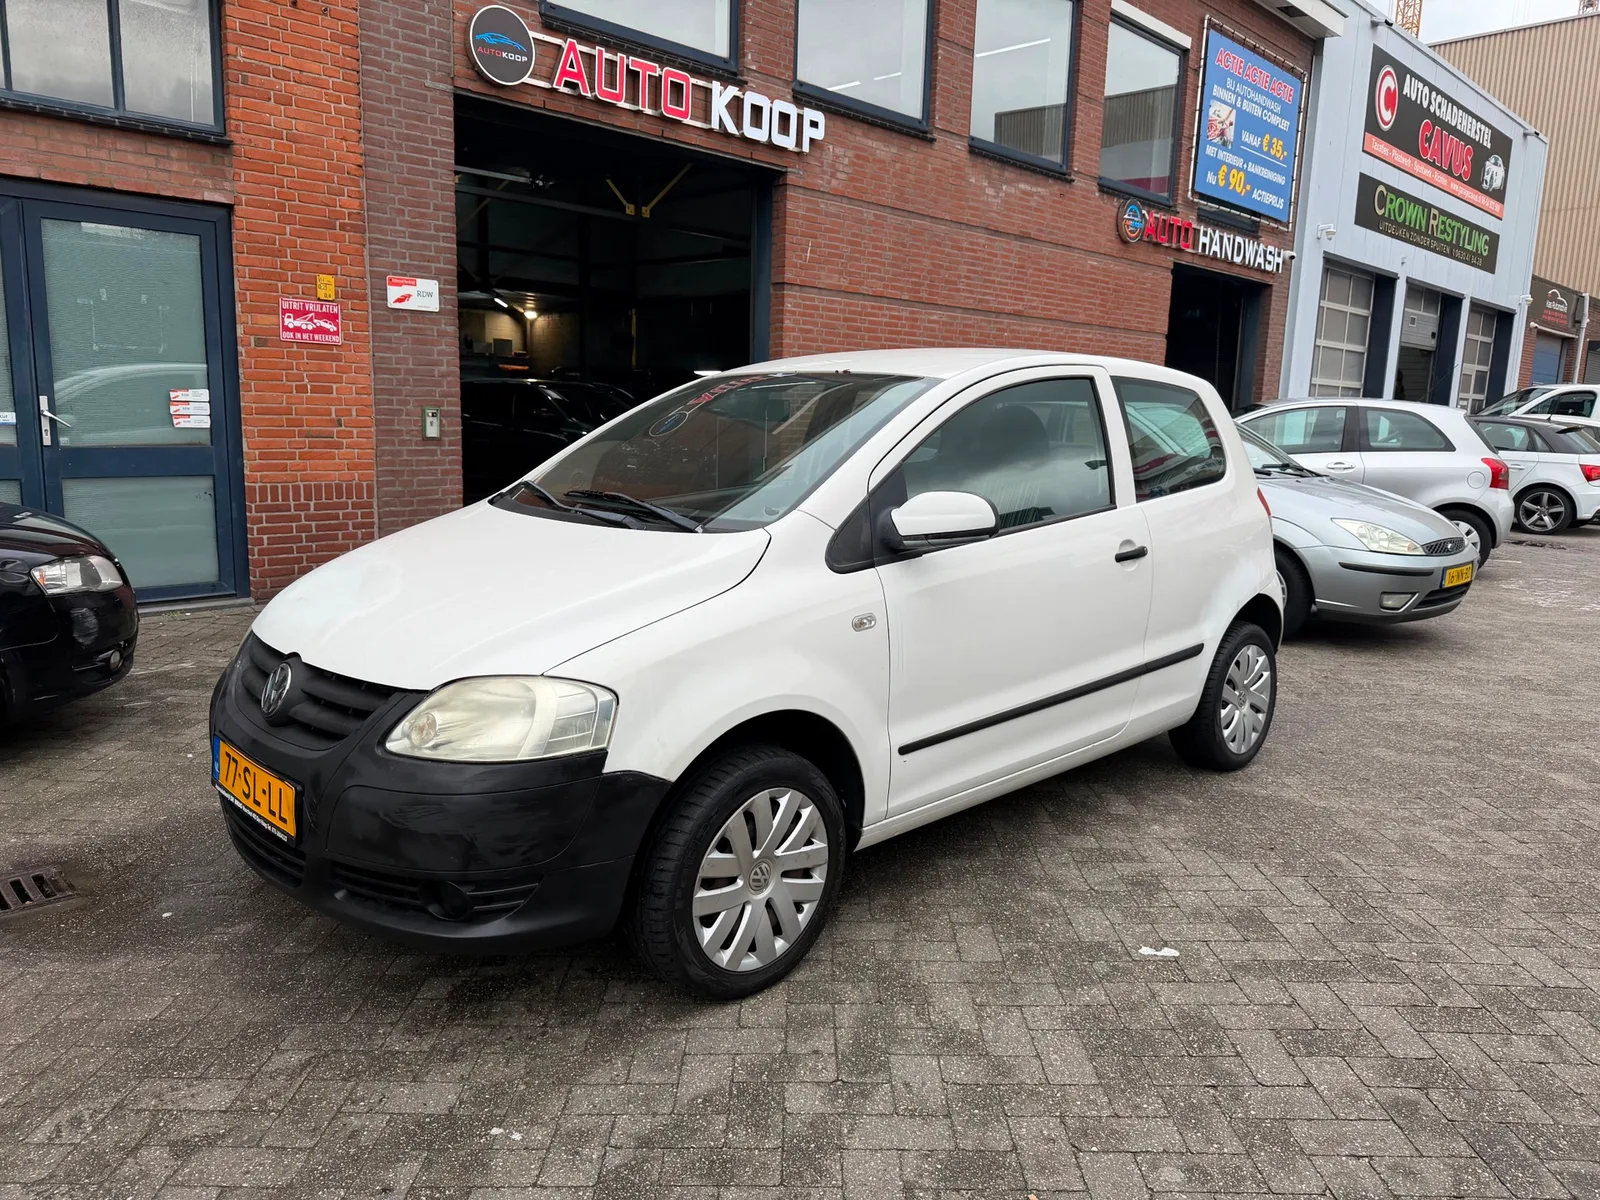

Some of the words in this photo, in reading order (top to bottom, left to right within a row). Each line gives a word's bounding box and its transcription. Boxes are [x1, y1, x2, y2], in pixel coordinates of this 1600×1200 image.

[477, 46, 528, 62] AUTOKOOP
[1215, 48, 1244, 77] ACTIE
[1243, 63, 1270, 91] ACTIE
[1269, 78, 1294, 104] ACTIE
[553, 38, 692, 121] AUTO
[711, 80, 825, 154] KOOP
[1212, 85, 1236, 105] BINNEN
[1236, 97, 1241, 107] &
[1242, 99, 1262, 118] BUITEN
[1262, 110, 1290, 132] COMPLEET
[1226, 78, 1235, 90] BIJ
[1235, 84, 1281, 114] AUTOHANDWASH
[1403, 74, 1429, 109] AUTO
[1429, 91, 1492, 149] SCHADEHERSTEL
[1241, 130, 1261, 148] VANAF
[1262, 134, 1270, 152] €
[1419, 119, 1474, 181] CAVUS
[1205, 144, 1217, 158] MET
[1217, 148, 1244, 168] INTERIEUR
[1247, 161, 1286, 185] BANKREINIGING
[1206, 170, 1217, 185] Nu
[1218, 164, 1228, 187] €
[1252, 188, 1284, 209] ACTIEPRIJS
[1144, 210, 1193, 249] AUTO
[1198, 225, 1284, 274] HANDWASH
[1374, 184, 1428, 231] CROWN
[1428, 207, 1490, 256] RESTYLING
[1379, 220, 1410, 240] UITDEUKEN
[1410, 231, 1430, 247] ZONDER
[1430, 240, 1450, 254] SPUITEN
[282, 300, 303, 311] UITRIT
[305, 302, 338, 314] VRIJLATEN
[416, 290, 433, 299] RDW
[302, 333, 313, 341] HET
[314, 334, 340, 343] WEEKEND
[225, 750, 287, 825] 77-SL-LL
